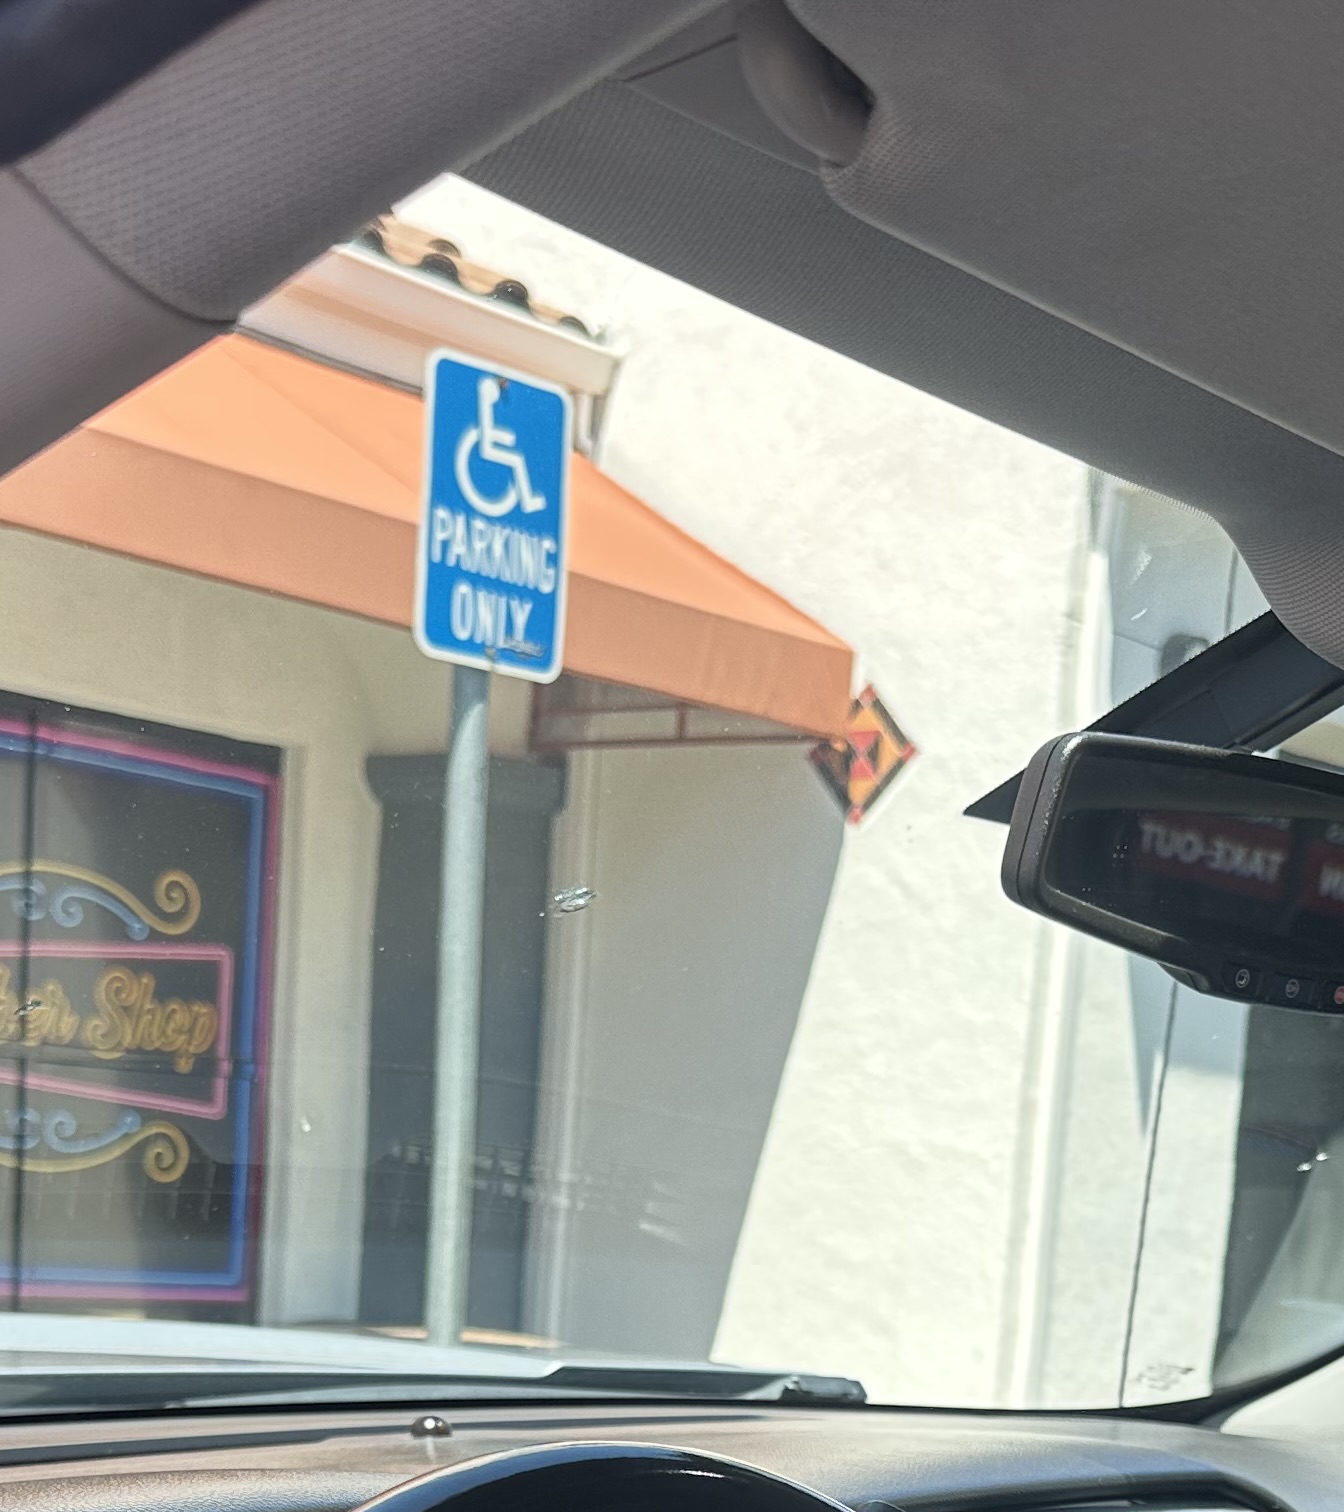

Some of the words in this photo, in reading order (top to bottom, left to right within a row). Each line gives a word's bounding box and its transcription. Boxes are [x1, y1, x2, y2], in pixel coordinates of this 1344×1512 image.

[431, 505, 555, 594] PARKING
[450, 581, 533, 648] ONLY
[85, 965, 216, 1073] Shop
